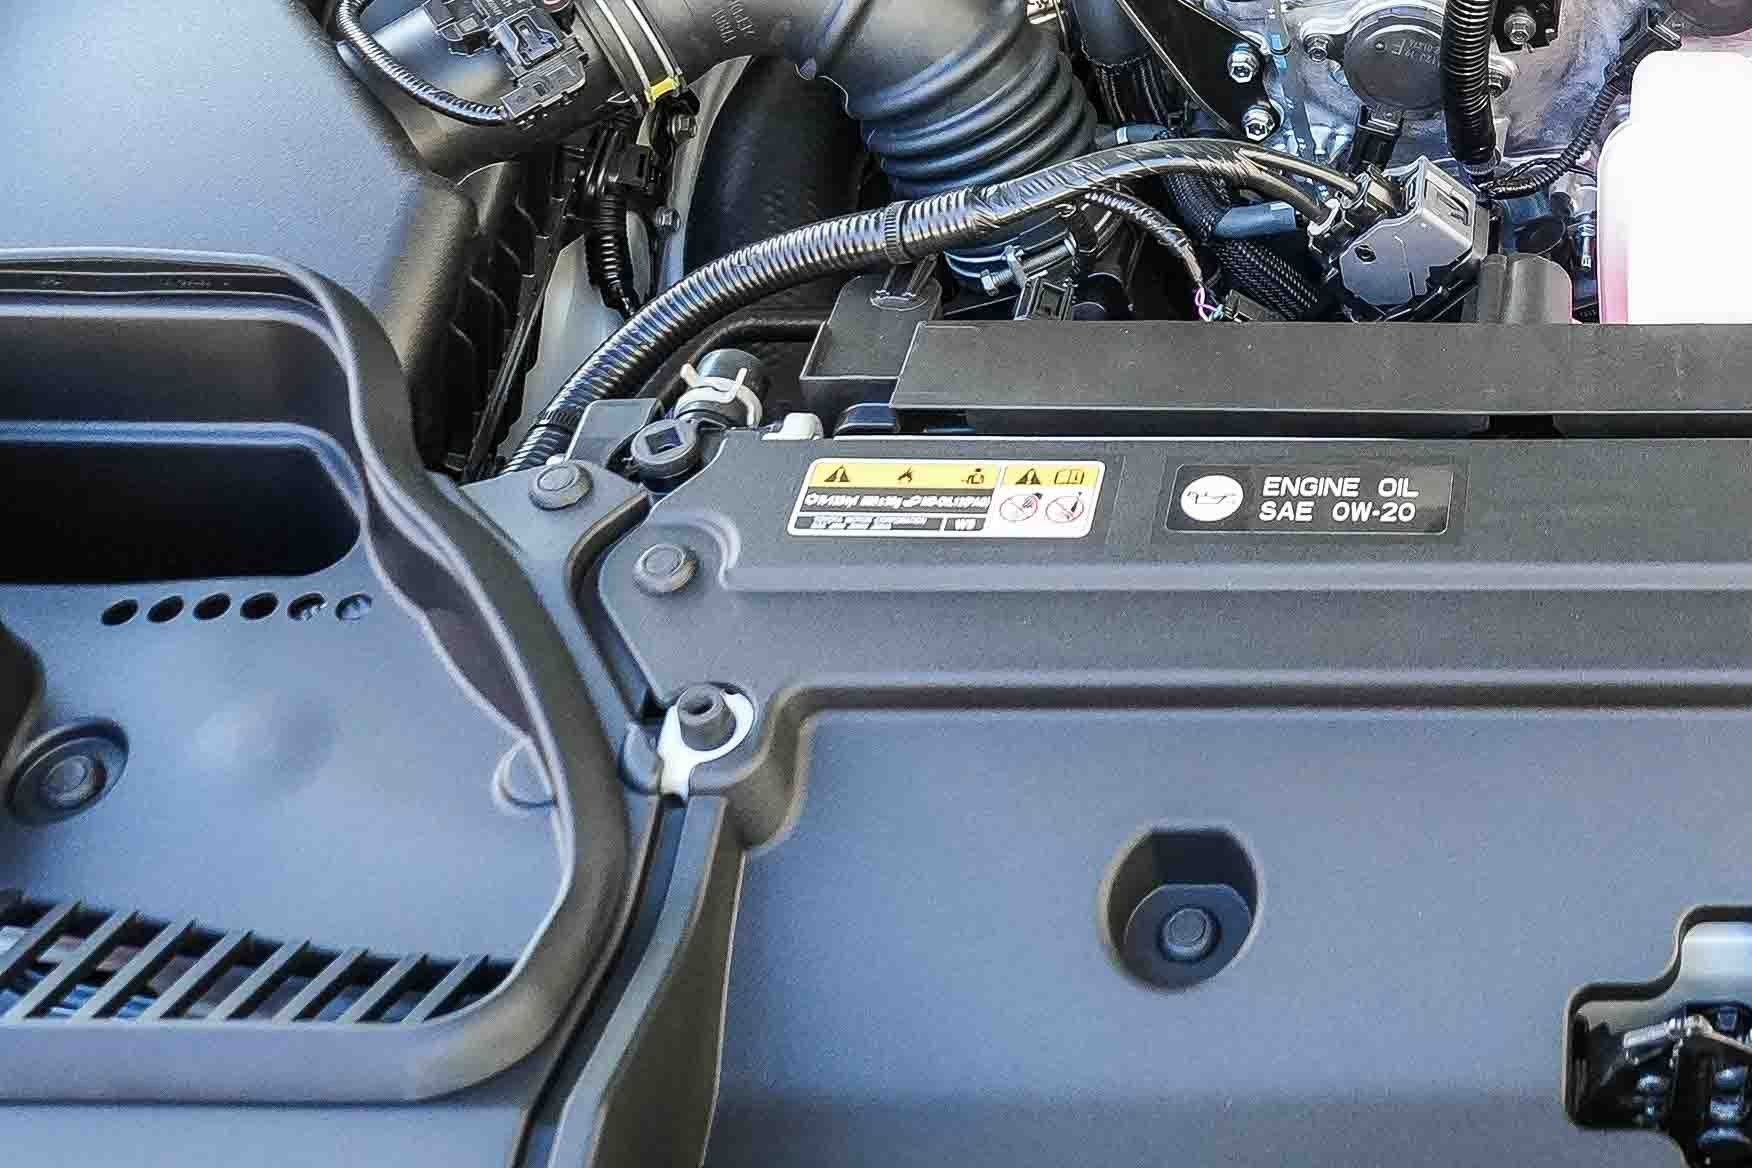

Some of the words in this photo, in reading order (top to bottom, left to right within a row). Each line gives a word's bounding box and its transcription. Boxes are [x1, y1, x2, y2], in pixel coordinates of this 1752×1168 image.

[1262, 476, 1361, 497] ENGINE
[1377, 476, 1419, 498] OIL
[1259, 501, 1314, 522] SAE
[1331, 501, 1417, 523] 0W-20
